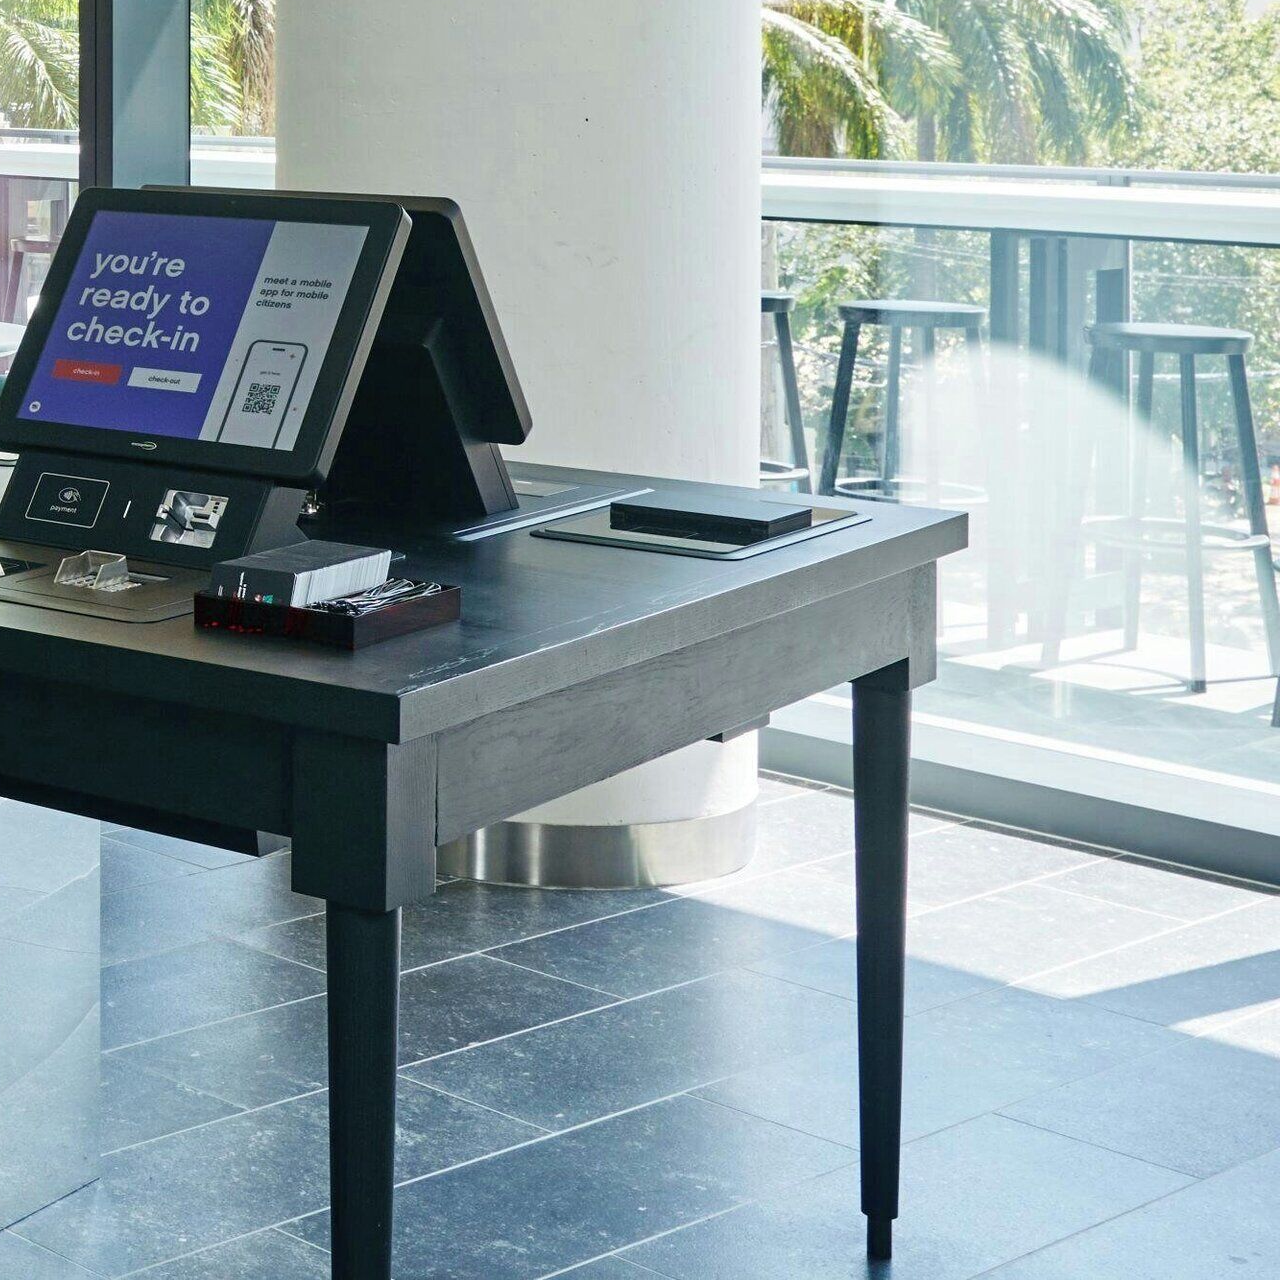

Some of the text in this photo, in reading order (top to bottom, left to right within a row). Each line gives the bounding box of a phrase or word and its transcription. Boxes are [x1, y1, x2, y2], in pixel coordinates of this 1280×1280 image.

[90, 251, 186, 279] you're
[263, 276, 289, 286] meet
[300, 279, 333, 289] mobile
[259, 288, 330, 300] app for mobile
[79, 285, 210, 320] ready to
[255, 299, 292, 309] citizens
[67, 315, 201, 353] check-in
[147, 374, 181, 385] check-out
[49, 504, 77, 514] payment
